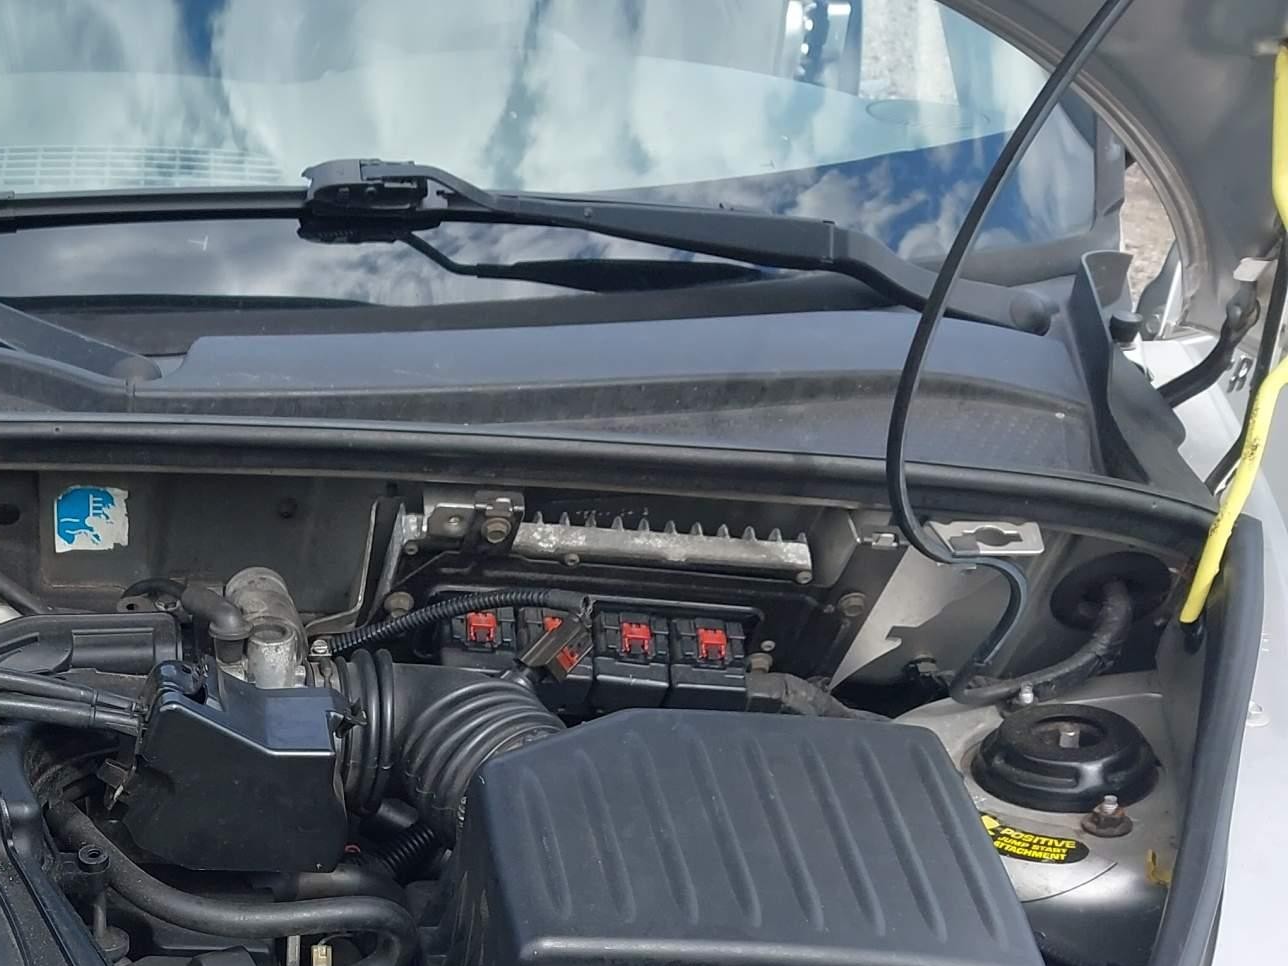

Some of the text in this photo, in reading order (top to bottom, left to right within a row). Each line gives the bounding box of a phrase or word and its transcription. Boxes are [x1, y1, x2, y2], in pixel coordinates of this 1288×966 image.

[997, 836, 1068, 853] JUMP START
[999, 827, 1077, 849] POSITIVE
